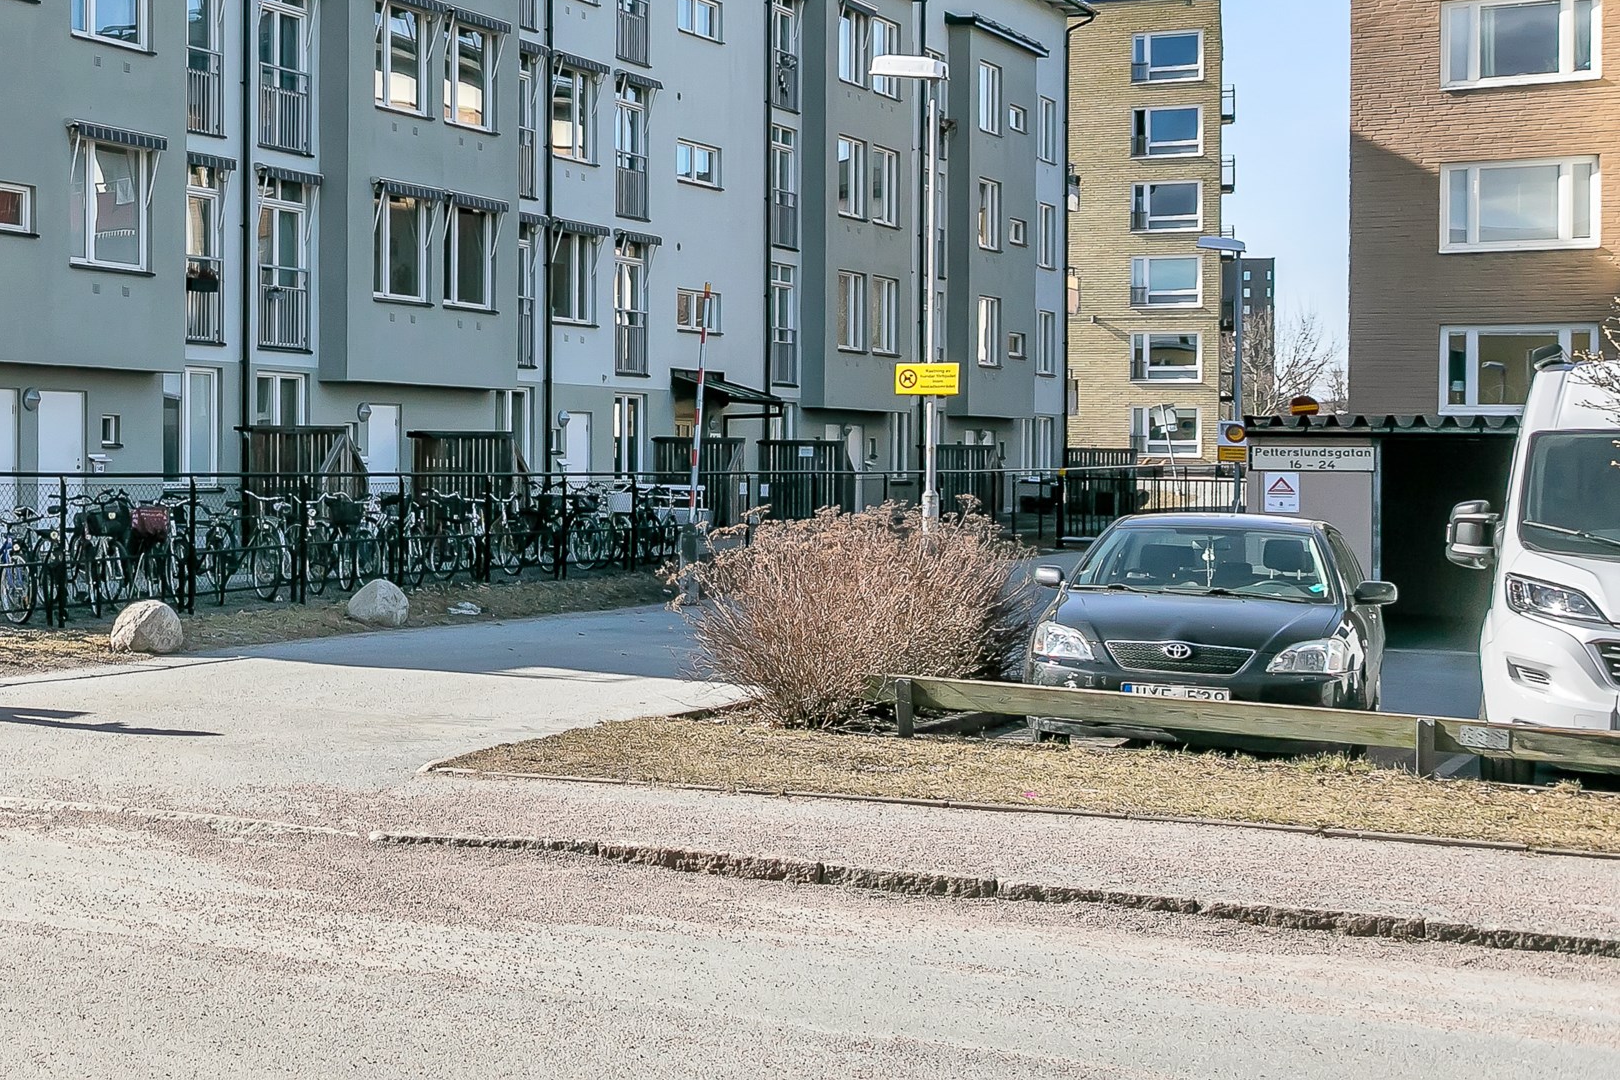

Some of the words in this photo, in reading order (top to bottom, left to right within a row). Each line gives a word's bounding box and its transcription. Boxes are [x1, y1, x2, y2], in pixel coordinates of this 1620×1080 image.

[1254, 447, 1372, 460] Petterslundsgatan
[1289, 459, 1303, 469] 16
[1318, 459, 1336, 470] 24
